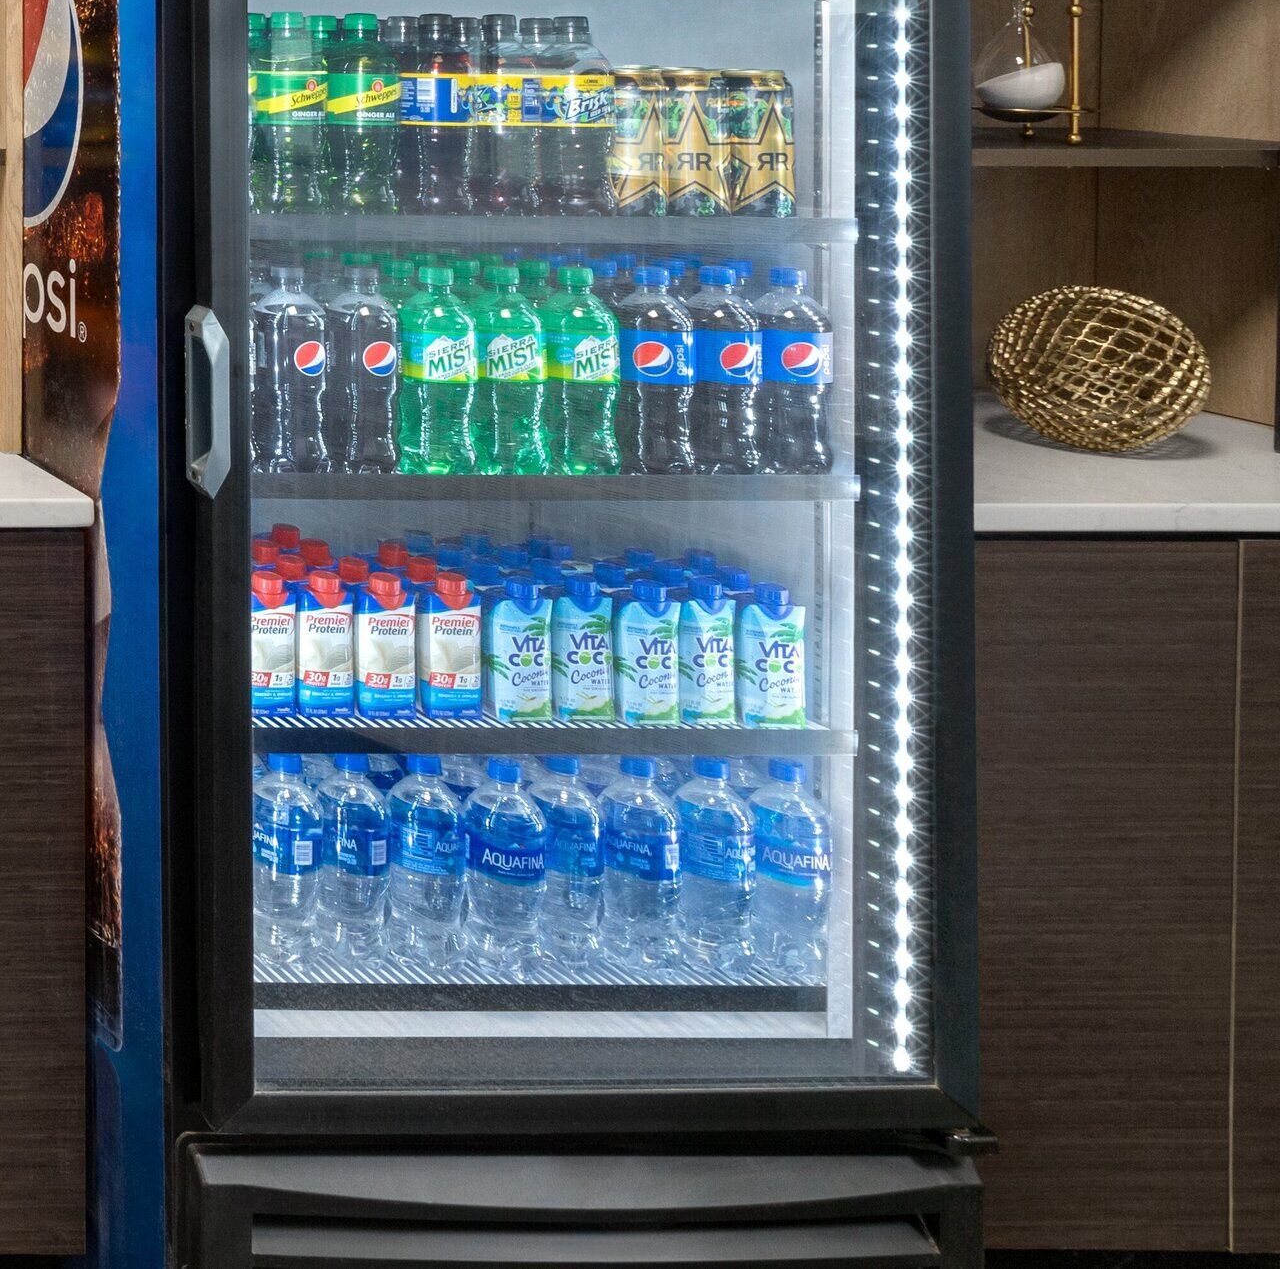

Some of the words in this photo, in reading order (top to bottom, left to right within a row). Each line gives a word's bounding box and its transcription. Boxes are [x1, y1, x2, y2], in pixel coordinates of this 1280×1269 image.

[291, 84, 326, 107] Schweppe
[429, 335, 471, 357] SIERRA
[488, 335, 534, 357] SIERRA
[575, 336, 617, 357] SIERRA
[428, 348, 473, 374] MIST
[490, 342, 536, 374] MIST
[576, 347, 618, 375] MIST
[676, 344, 686, 376] pepsi
[822, 344, 830, 376] pepsi
[306, 614, 347, 626] Premier
[308, 624, 346, 634] Protein
[368, 617, 410, 628] Premier
[432, 617, 475, 628] Premier
[370, 627, 407, 636] Protein
[435, 627, 473, 636] Protein
[512, 634, 545, 652] VITA
[570, 632, 608, 650] VITA
[640, 637, 676, 655] VITA
[696, 636, 733, 653] VITA
[758, 641, 800, 659] VITA
[309, 673, 326, 682] 30g
[370, 674, 389, 684] 30g
[434, 673, 452, 684] 30g
[553, 838, 596, 853] AQUAFINA
[605, 836, 651, 855] AQUAFINA
[482, 848, 544, 871] AQUAFINA
[762, 846, 830, 871] AQUAFINA
